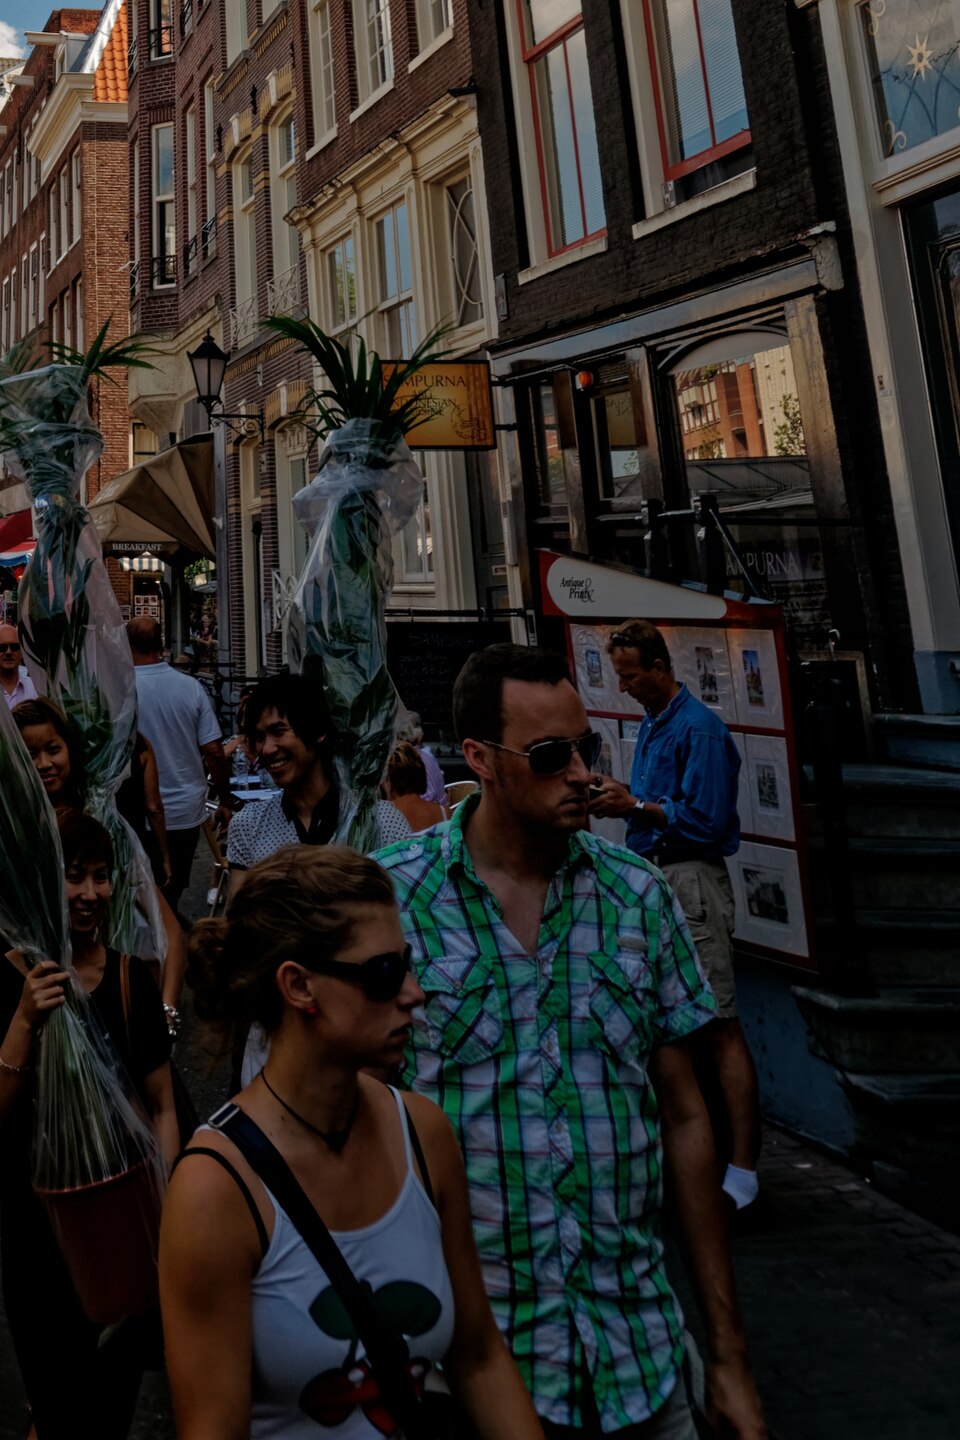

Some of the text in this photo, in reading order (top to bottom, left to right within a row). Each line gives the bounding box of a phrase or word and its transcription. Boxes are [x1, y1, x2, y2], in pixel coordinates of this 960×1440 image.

[383, 374, 467, 387] SMPURNA
[112, 543, 163, 551] BREAKFAST
[559, 576, 585, 589] Antique
